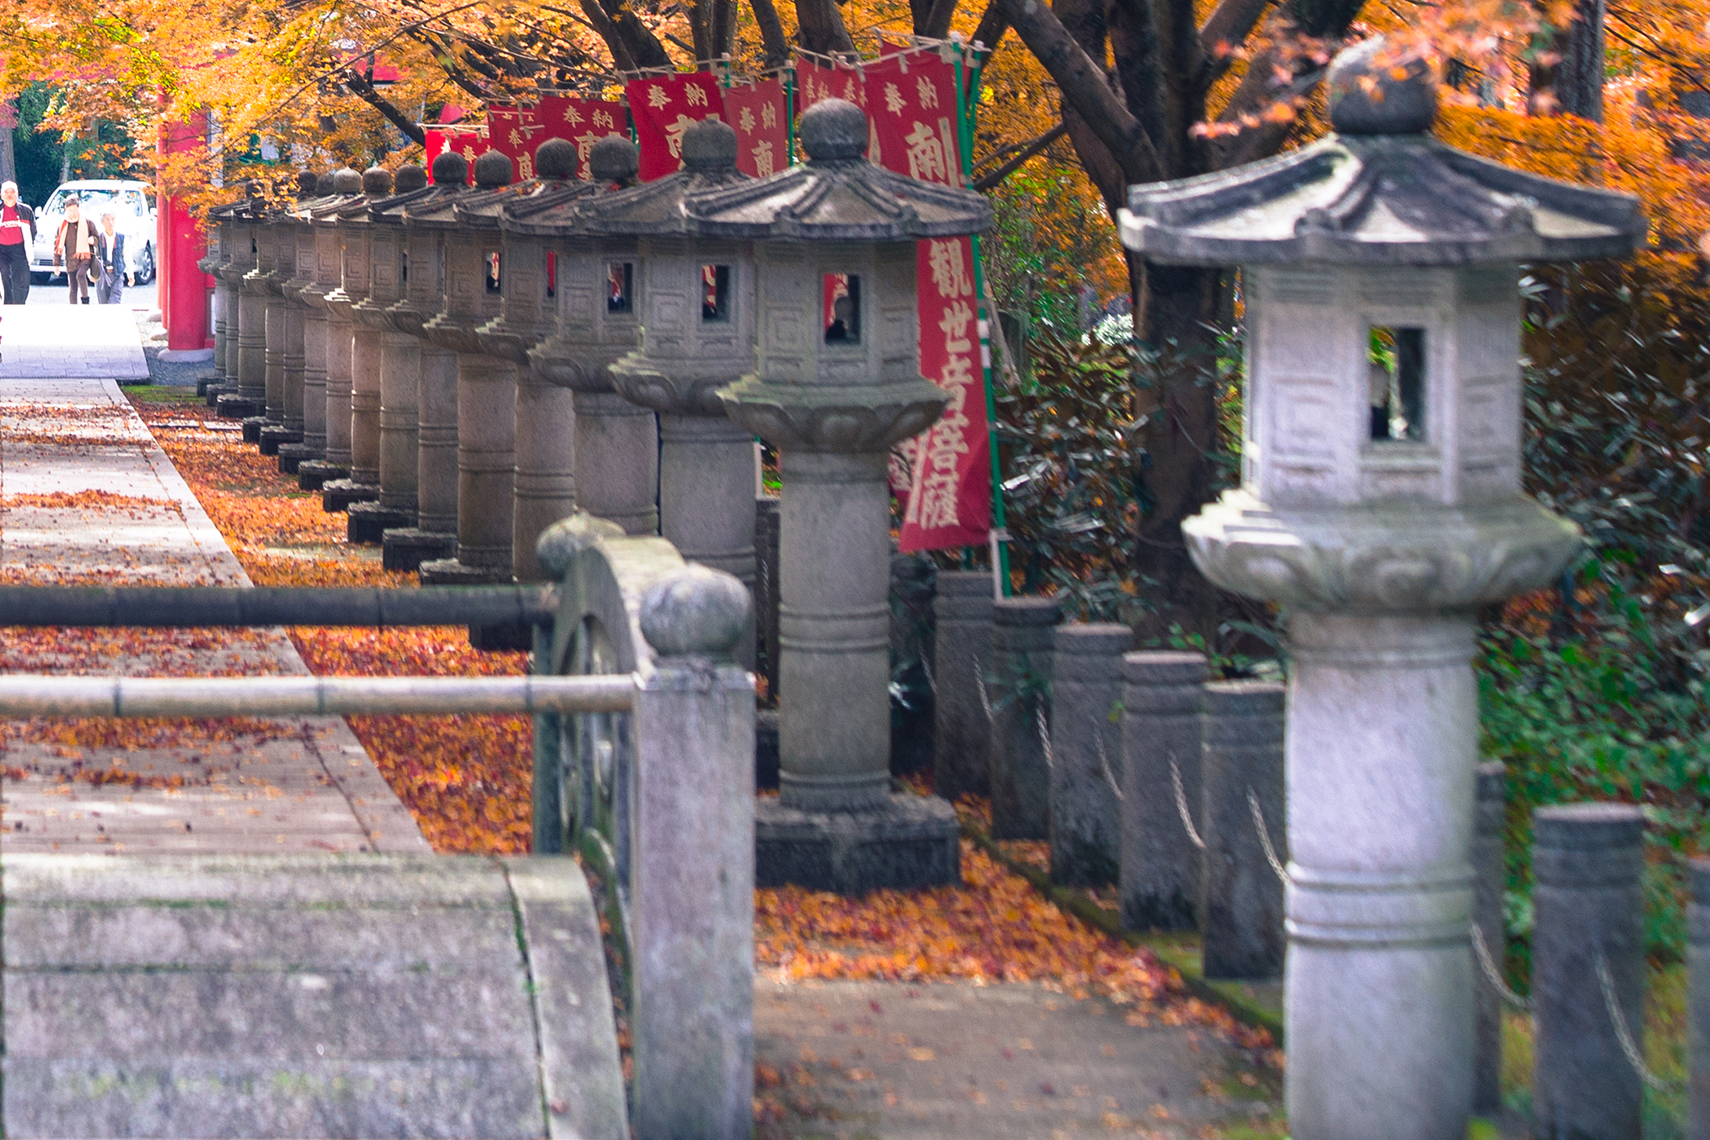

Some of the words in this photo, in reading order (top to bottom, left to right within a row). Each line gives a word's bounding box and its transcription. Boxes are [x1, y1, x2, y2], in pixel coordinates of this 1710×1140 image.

[647, 82, 708, 111] 奉納
[884, 75, 939, 117] 奉納
[563, 105, 614, 129] 奉納
[739, 100, 776, 136] 奉納
